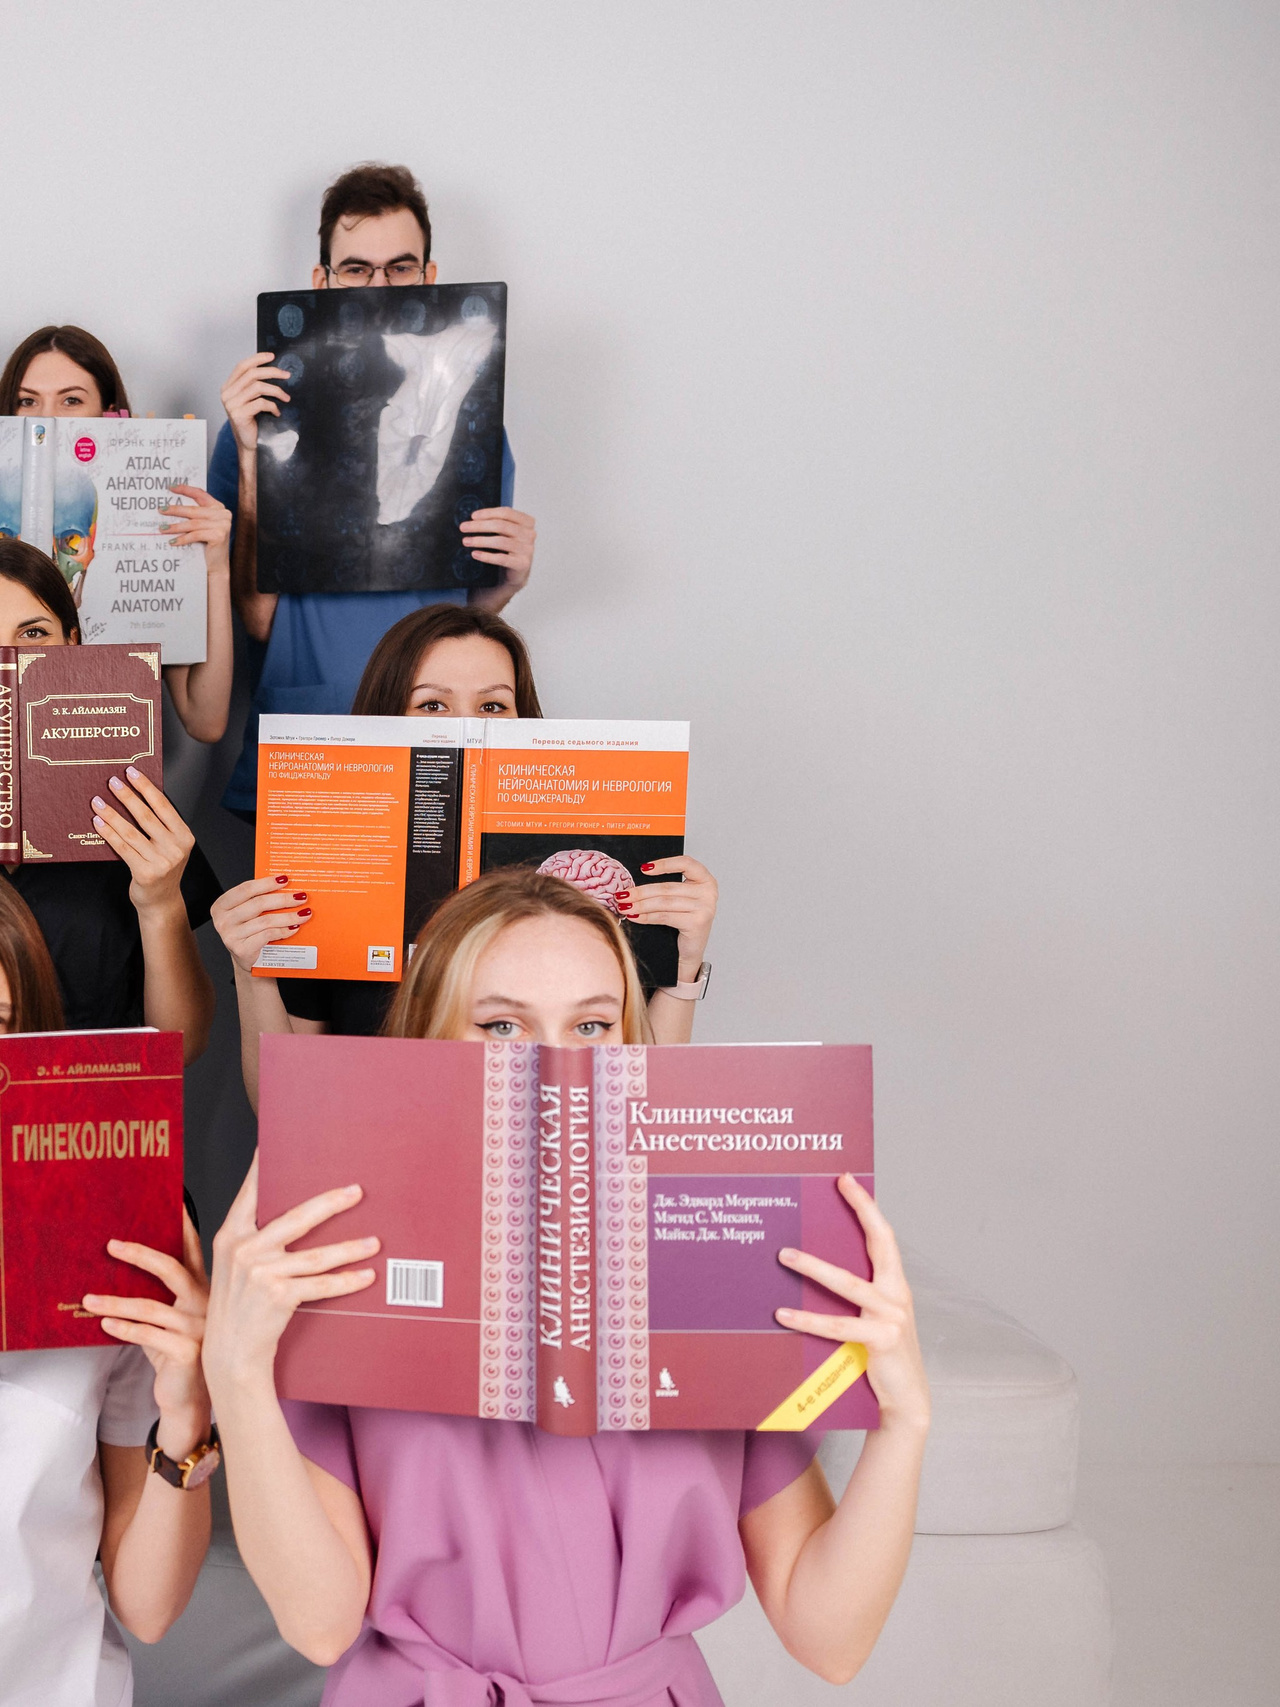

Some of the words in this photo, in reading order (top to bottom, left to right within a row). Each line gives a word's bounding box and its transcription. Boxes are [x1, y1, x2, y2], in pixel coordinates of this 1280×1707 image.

[109, 438, 145, 447] ФРЭНК
[149, 438, 186, 447] НЕТТЕР
[126, 456, 171, 470] АТЛАС
[102, 543, 135, 551] FRANK
[141, 543, 150, 551] H.
[115, 559, 158, 573] ATLAS
[162, 559, 180, 573] OF
[120, 579, 175, 593] HUMAN
[110, 598, 184, 613] ANATOMY
[72, 706, 127, 715] АЙЛАМАЗЯН
[41, 726, 140, 739] АКУШЕРСТВО
[532, 738, 565, 746] Перевод
[269, 751, 325, 761] КЛИНИЧЕСКАЯ
[269, 761, 335, 771] НЕЙРОАНАТОМИЯ
[336, 763, 342, 771] И
[343, 763, 394, 773] НЕВРОЛОГИЯ
[498, 764, 575, 777] КЛИНИЧЕСКАЯ
[269, 771, 278, 779] ПО
[279, 772, 331, 780] ФИЦДЖЕРАЛЬДУ
[469, 764, 477, 803] КЛИНИЧЕСКАЯ
[498, 777, 589, 791] НЕЙРОАНАТОМИЯ
[592, 780, 600, 791] И
[602, 780, 672, 792] НЕВРОЛОГИЯ
[497, 792, 510, 803] ПО
[511, 793, 586, 805] ФИЦДЖЕРАЛЬДУ
[496, 820, 524, 828] ЭСТОМИХ
[37, 1065, 50, 1077] Э.
[53, 1065, 65, 1076] К.
[67, 1062, 141, 1075] АЙЛАМАЗЯН
[629, 1101, 794, 1125] Клиническая
[12, 1119, 170, 1163] ГИНЕКОЛОГИЯ
[628, 1127, 844, 1152] Анестезиология
[679, 1194, 724, 1211] Эдвард
[539, 1083, 563, 1350] КЛИНИЧЕСКАЯ
[569, 1086, 591, 1352] АНЕСТЕЗИОЛОГИЯ
[654, 1211, 694, 1225] Мэгид
[695, 1211, 709, 1224] С.
[710, 1211, 763, 1225] Михаил,
[654, 1227, 695, 1241] Майкл
[696, 1227, 721, 1242] Дж.
[722, 1227, 765, 1245] Марри
[797, 1395, 816, 1413] 4-е
[814, 1355, 855, 1396] издание
